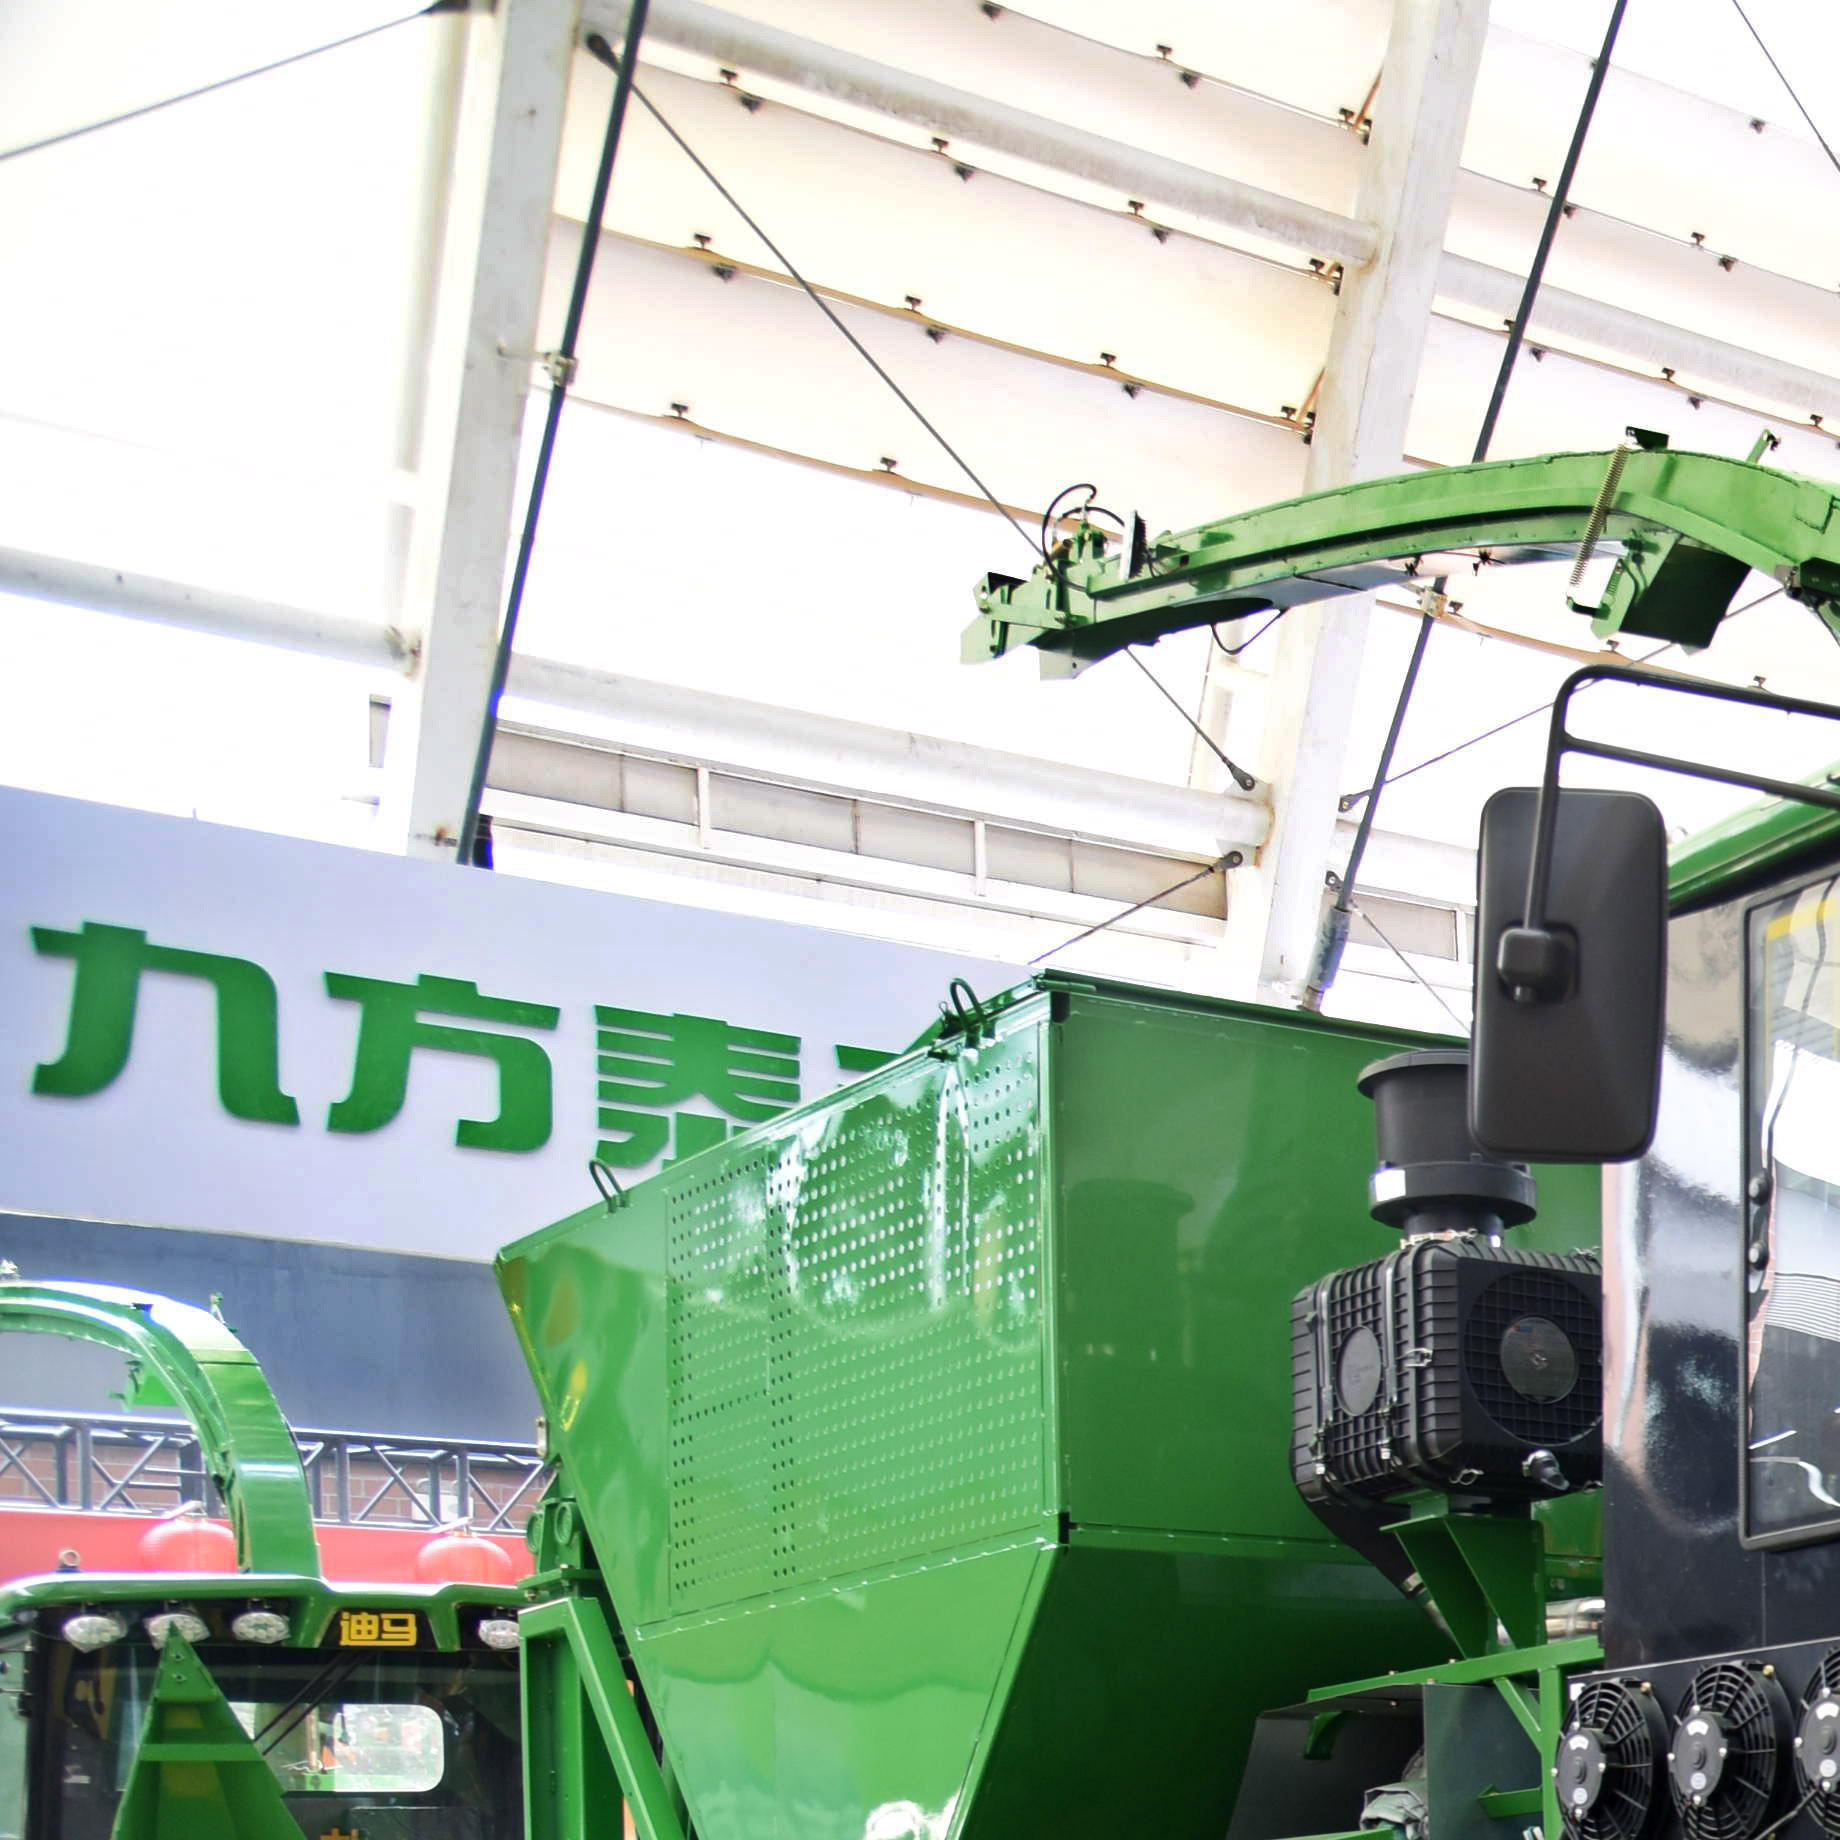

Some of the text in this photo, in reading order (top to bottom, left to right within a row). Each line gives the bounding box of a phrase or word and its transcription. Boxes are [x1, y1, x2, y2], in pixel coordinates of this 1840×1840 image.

[30, 920, 912, 1168] 九方泰
[338, 1611, 418, 1648] 迪马
